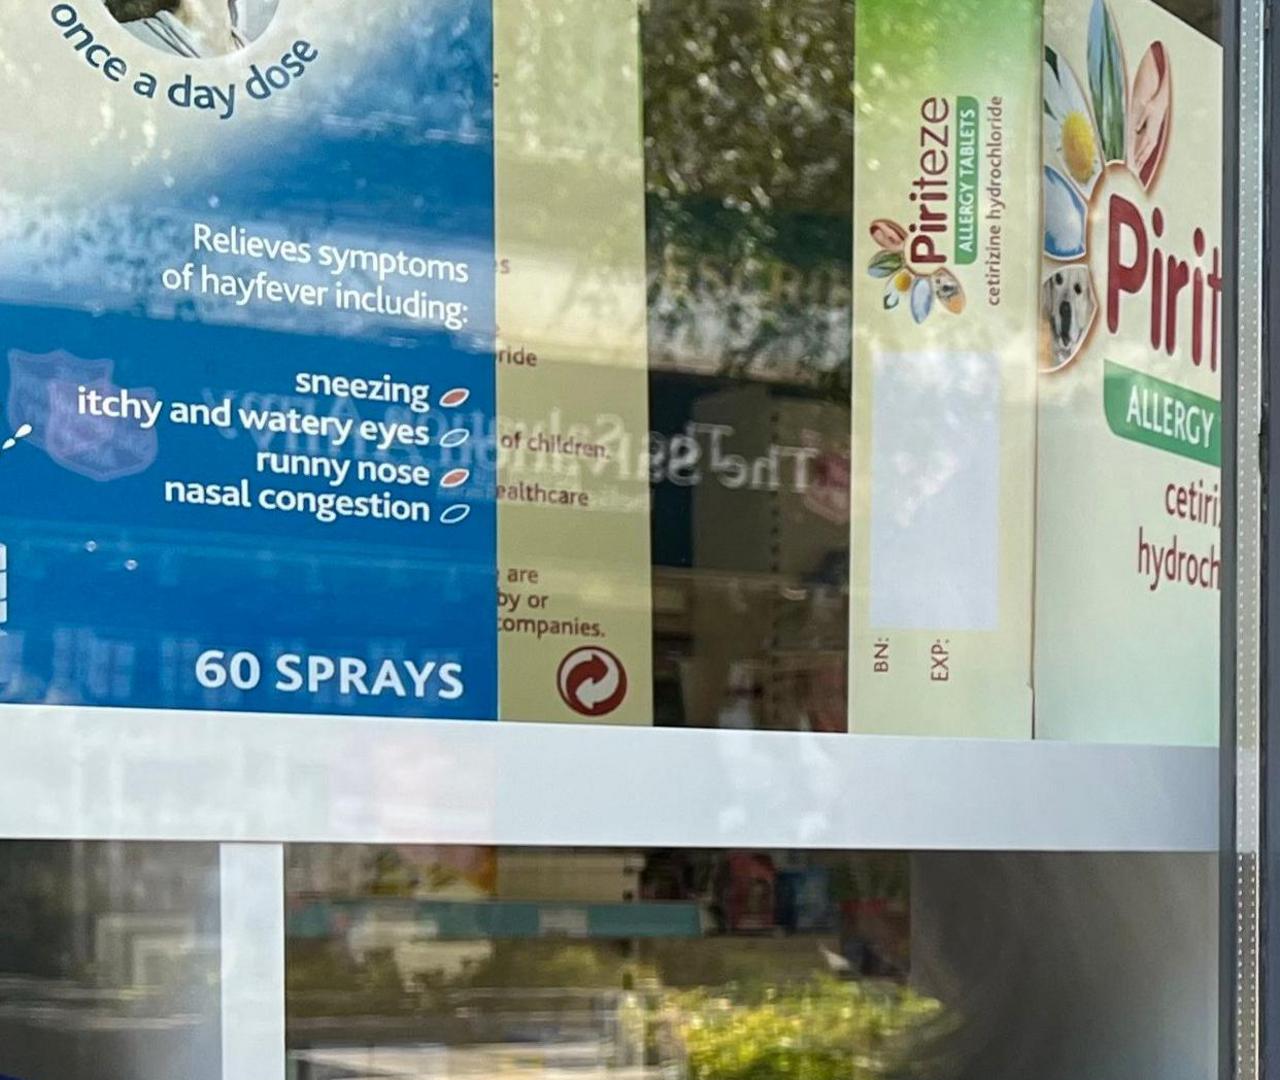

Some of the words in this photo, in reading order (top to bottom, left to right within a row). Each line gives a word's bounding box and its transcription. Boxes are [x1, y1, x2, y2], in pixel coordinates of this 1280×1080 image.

[51, 3, 127, 82] once
[133, 72, 157, 99] a
[168, 74, 235, 120] day
[246, 40, 318, 100] dose
[958, 109, 975, 176] TABLETS
[986, 96, 1005, 219] hydrochloride
[908, 96, 950, 264] Piriteze
[958, 182, 975, 252] ALLERGY
[193, 223, 311, 264] Relieves
[319, 246, 468, 282] symptoms
[986, 224, 1001, 307] cetirizine
[162, 263, 193, 291] of
[201, 264, 328, 306] hayfever
[336, 282, 469, 330] including:
[1107, 193, 1222, 373] Pirit
[78, 386, 162, 429] itchy
[170, 399, 230, 425] and
[238, 409, 352, 445] watery
[360, 419, 430, 450] eyes
[296, 372, 430, 413] sneezing
[1126, 384, 1215, 449] ALLERGY
[256, 449, 351, 487] runny
[358, 457, 430, 487] nose
[501, 431, 521, 449] of
[164, 478, 251, 509] nasal
[259, 485, 430, 524] congestion
[1165, 478, 1222, 529] cetiri
[507, 567, 539, 584] are
[527, 593, 548, 609] or
[195, 649, 260, 690] 60
[276, 654, 464, 700] SPRAYS
[873, 636, 890, 674] BN:
[931, 637, 950, 682] EXP:
